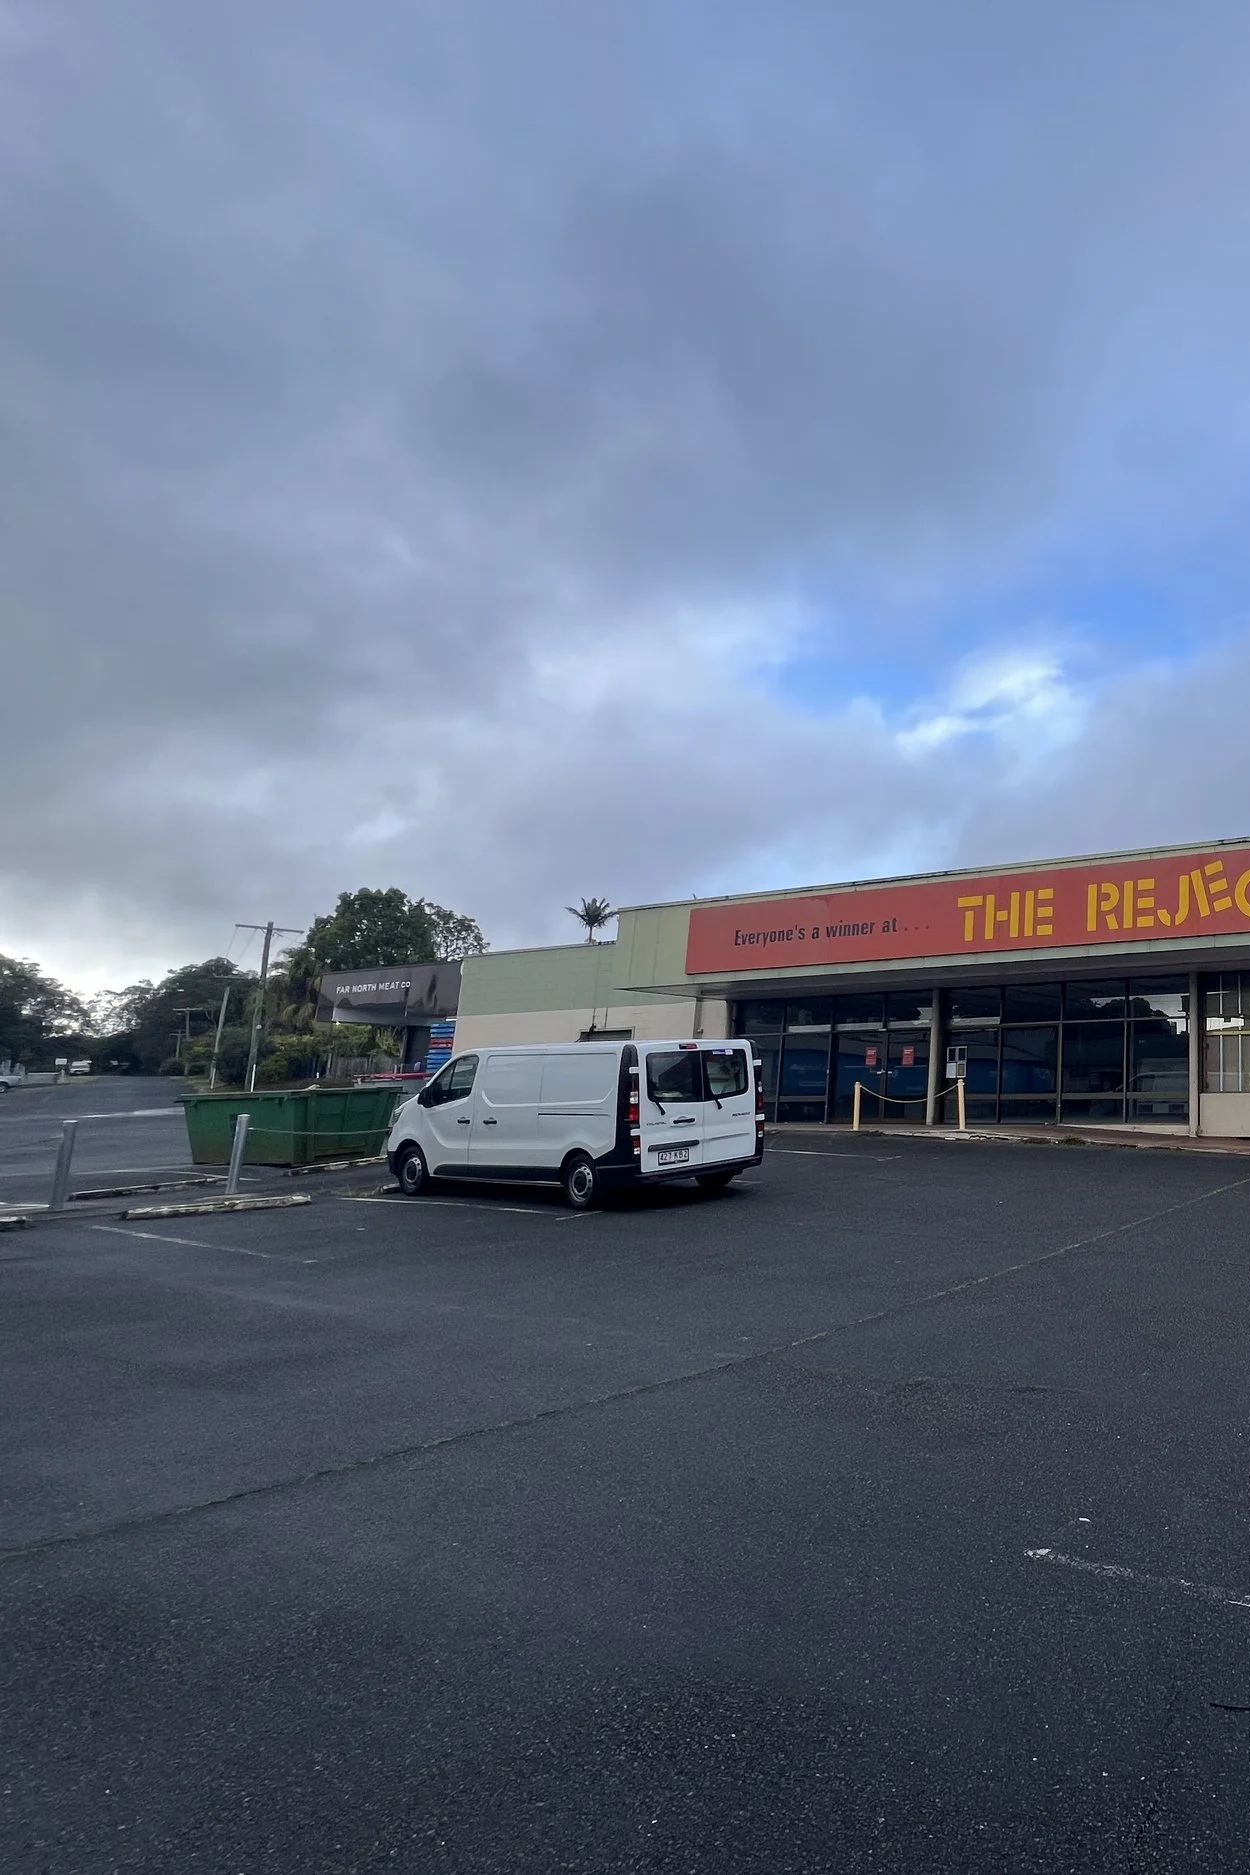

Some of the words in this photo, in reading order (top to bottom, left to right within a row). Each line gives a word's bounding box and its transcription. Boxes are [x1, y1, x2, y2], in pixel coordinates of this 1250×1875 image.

[957, 888, 1054, 942] THE
[734, 925, 806, 948] Everyone's
[811, 927, 820, 939] a
[826, 920, 876, 938] winner
[882, 917, 898, 933] at
[336, 985, 350, 994] FAR
[352, 983, 377, 993] NORTH
[379, 981, 400, 991] MEAT
[401, 980, 411, 988] CO
